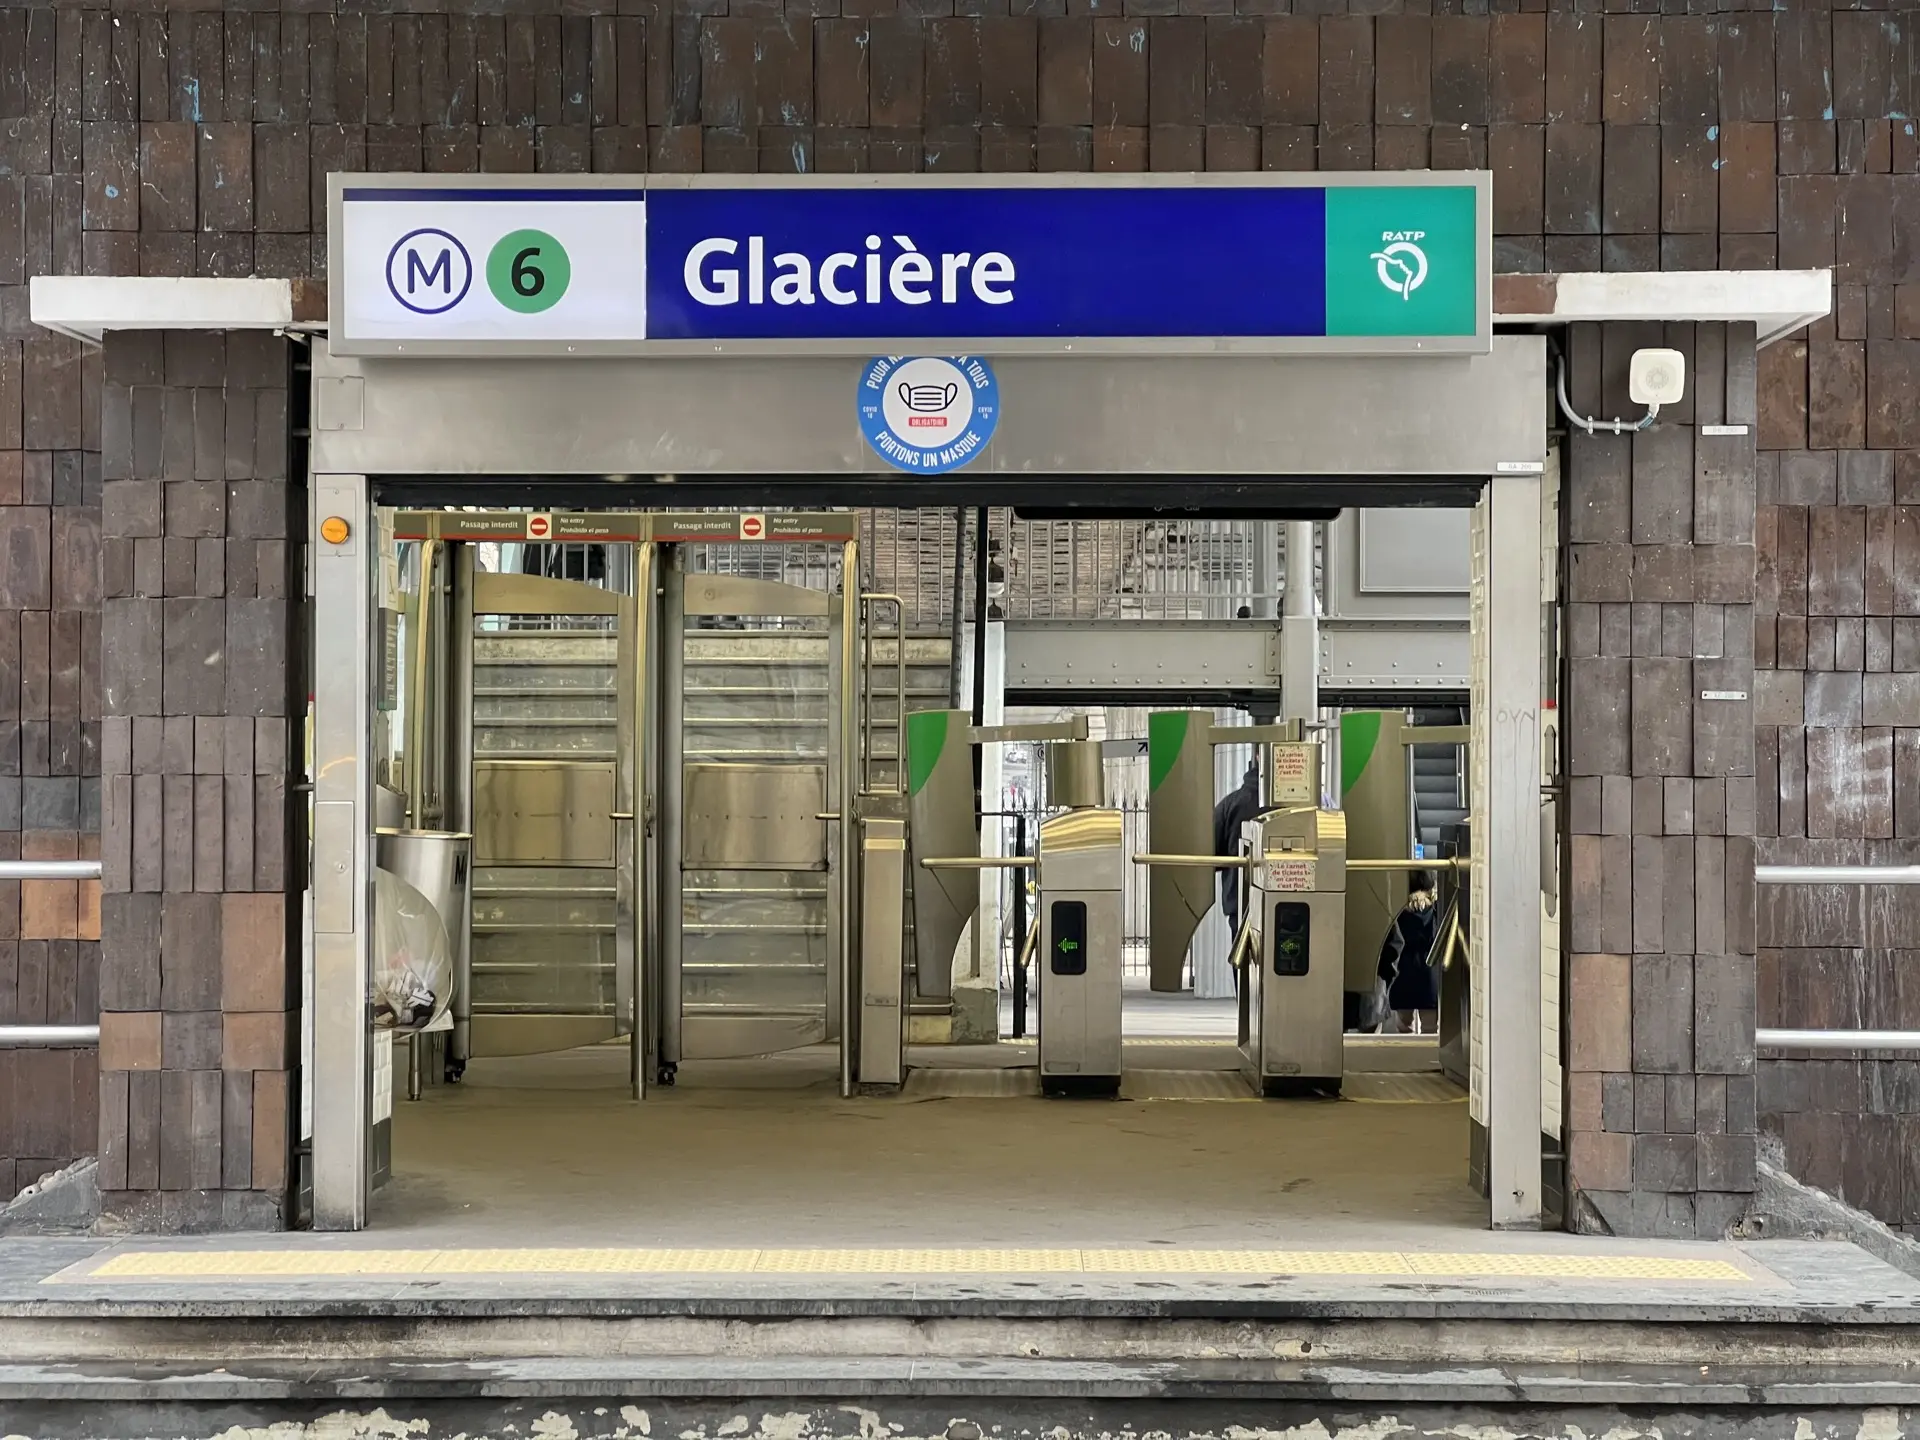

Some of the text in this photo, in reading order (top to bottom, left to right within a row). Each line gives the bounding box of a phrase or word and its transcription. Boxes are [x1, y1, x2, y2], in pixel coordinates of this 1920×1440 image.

[1382, 231, 1426, 241] RATP
[407, 247, 545, 297] M 6
[684, 234, 1016, 306] Glacière
[866, 359, 891, 390] POUR
[966, 359, 990, 389] TOUS
[875, 430, 981, 467] PORTONS UN MASQUE
[460, 520, 519, 530] Passage interdit
[673, 521, 732, 531] Passage interdit
